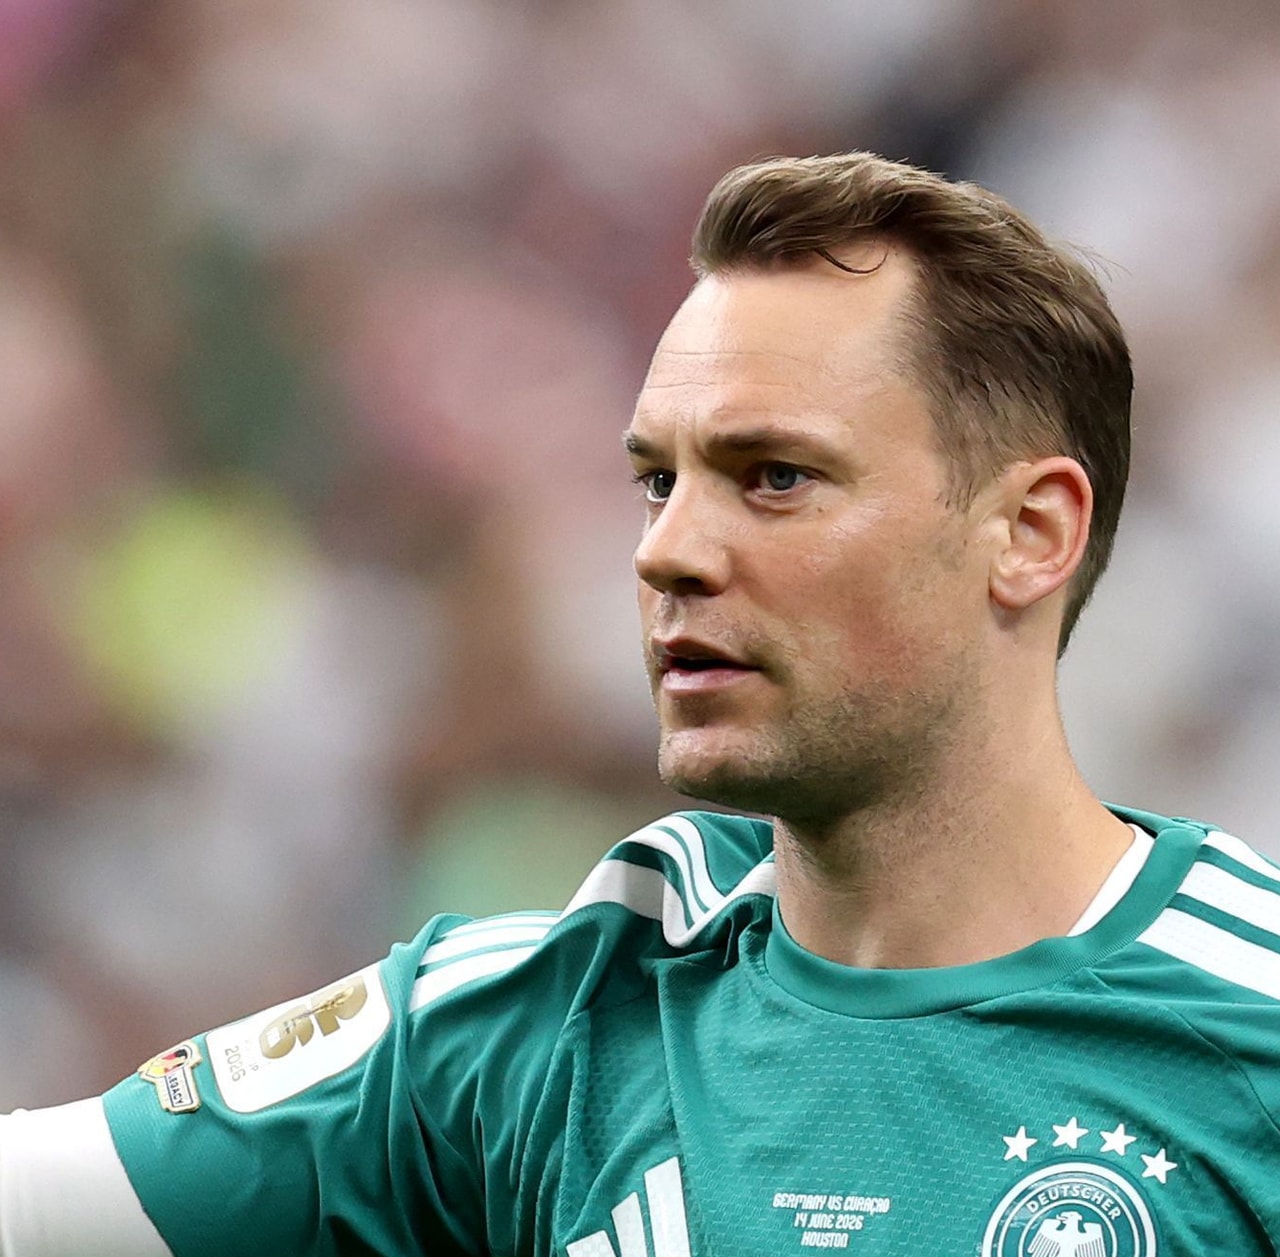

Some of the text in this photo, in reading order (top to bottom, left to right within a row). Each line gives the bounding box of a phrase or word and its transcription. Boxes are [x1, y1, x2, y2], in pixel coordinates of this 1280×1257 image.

[224, 1046, 246, 1082] 2026
[773, 1193, 891, 1216] GERMANY VS CURAÇAO
[1025, 1185, 1122, 1220] DEUTSCHER
[794, 1212, 864, 1230] 14 JUNE 2026
[801, 1231, 849, 1248] HOUSTON
